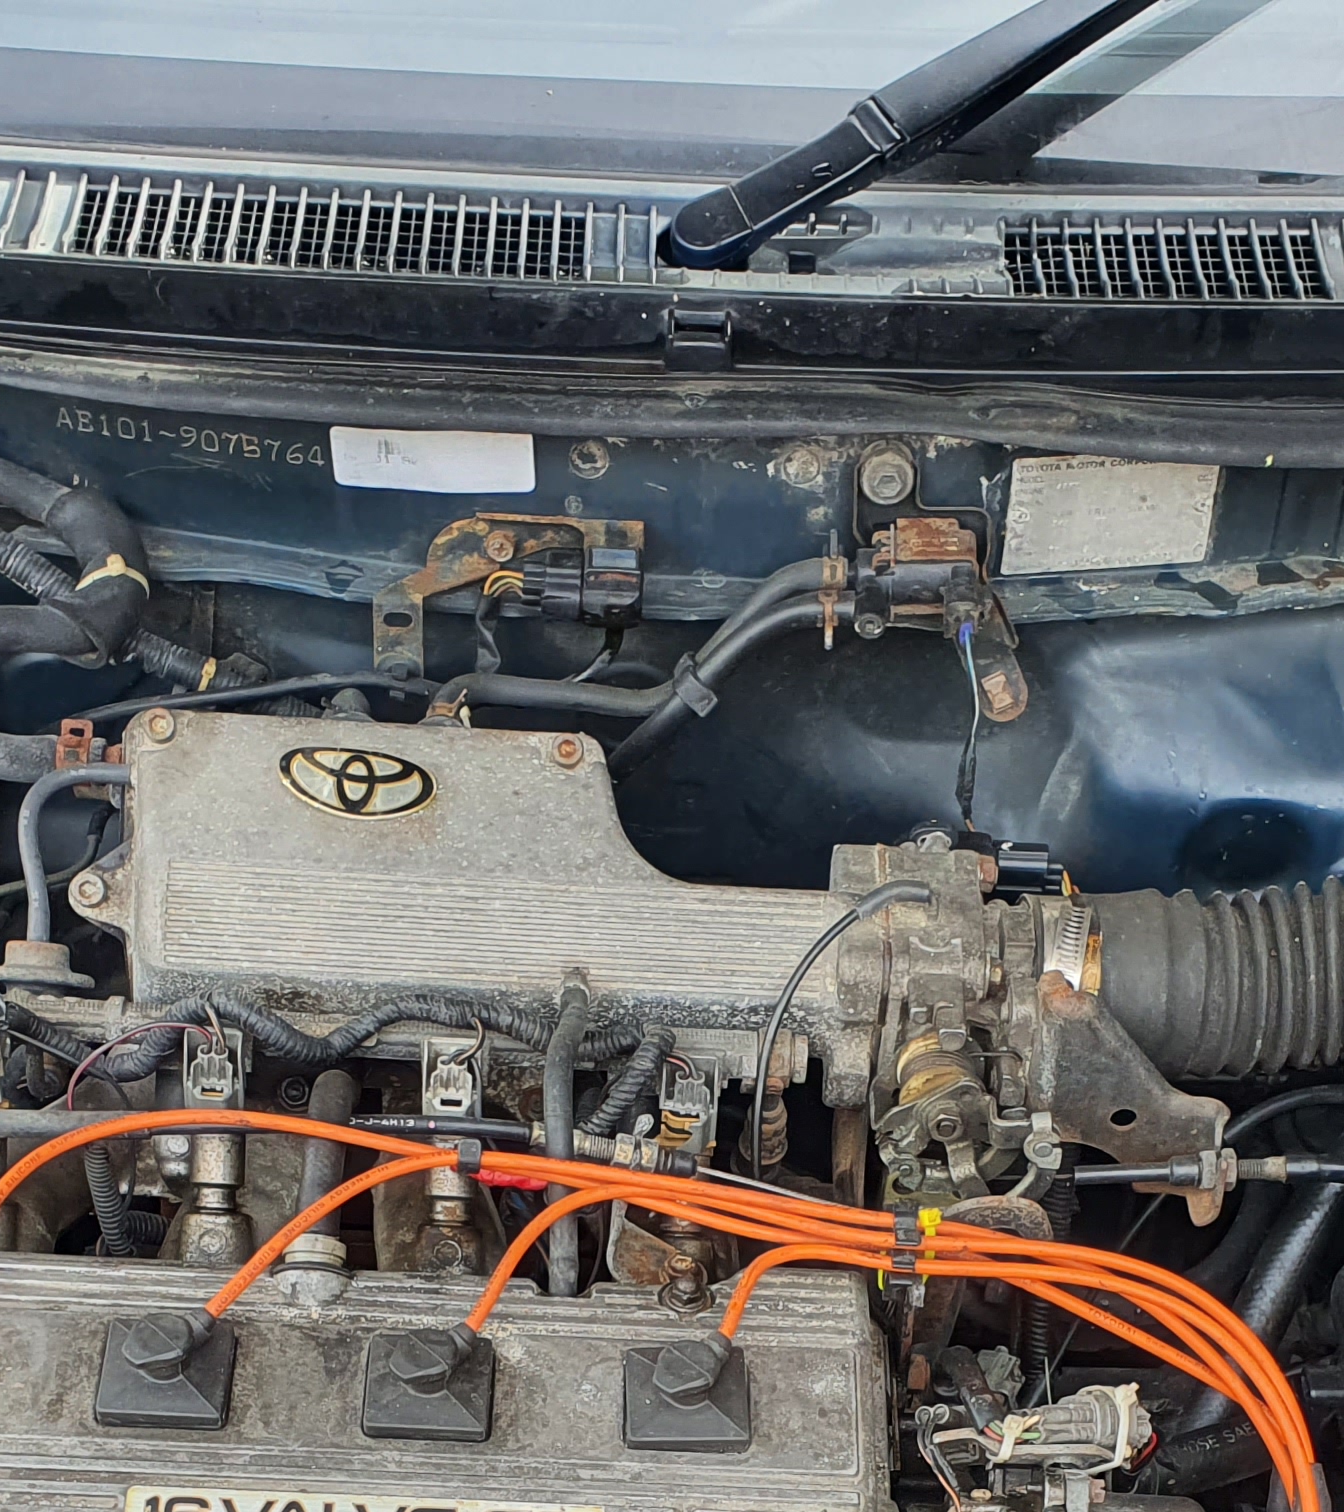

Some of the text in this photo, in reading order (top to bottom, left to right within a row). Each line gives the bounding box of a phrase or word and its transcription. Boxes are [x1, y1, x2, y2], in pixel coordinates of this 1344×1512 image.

[1018, 463, 1062, 474] TOYOTA
[1066, 460, 1106, 470] MOTOR
[283, 1201, 325, 1241] SILICONE
